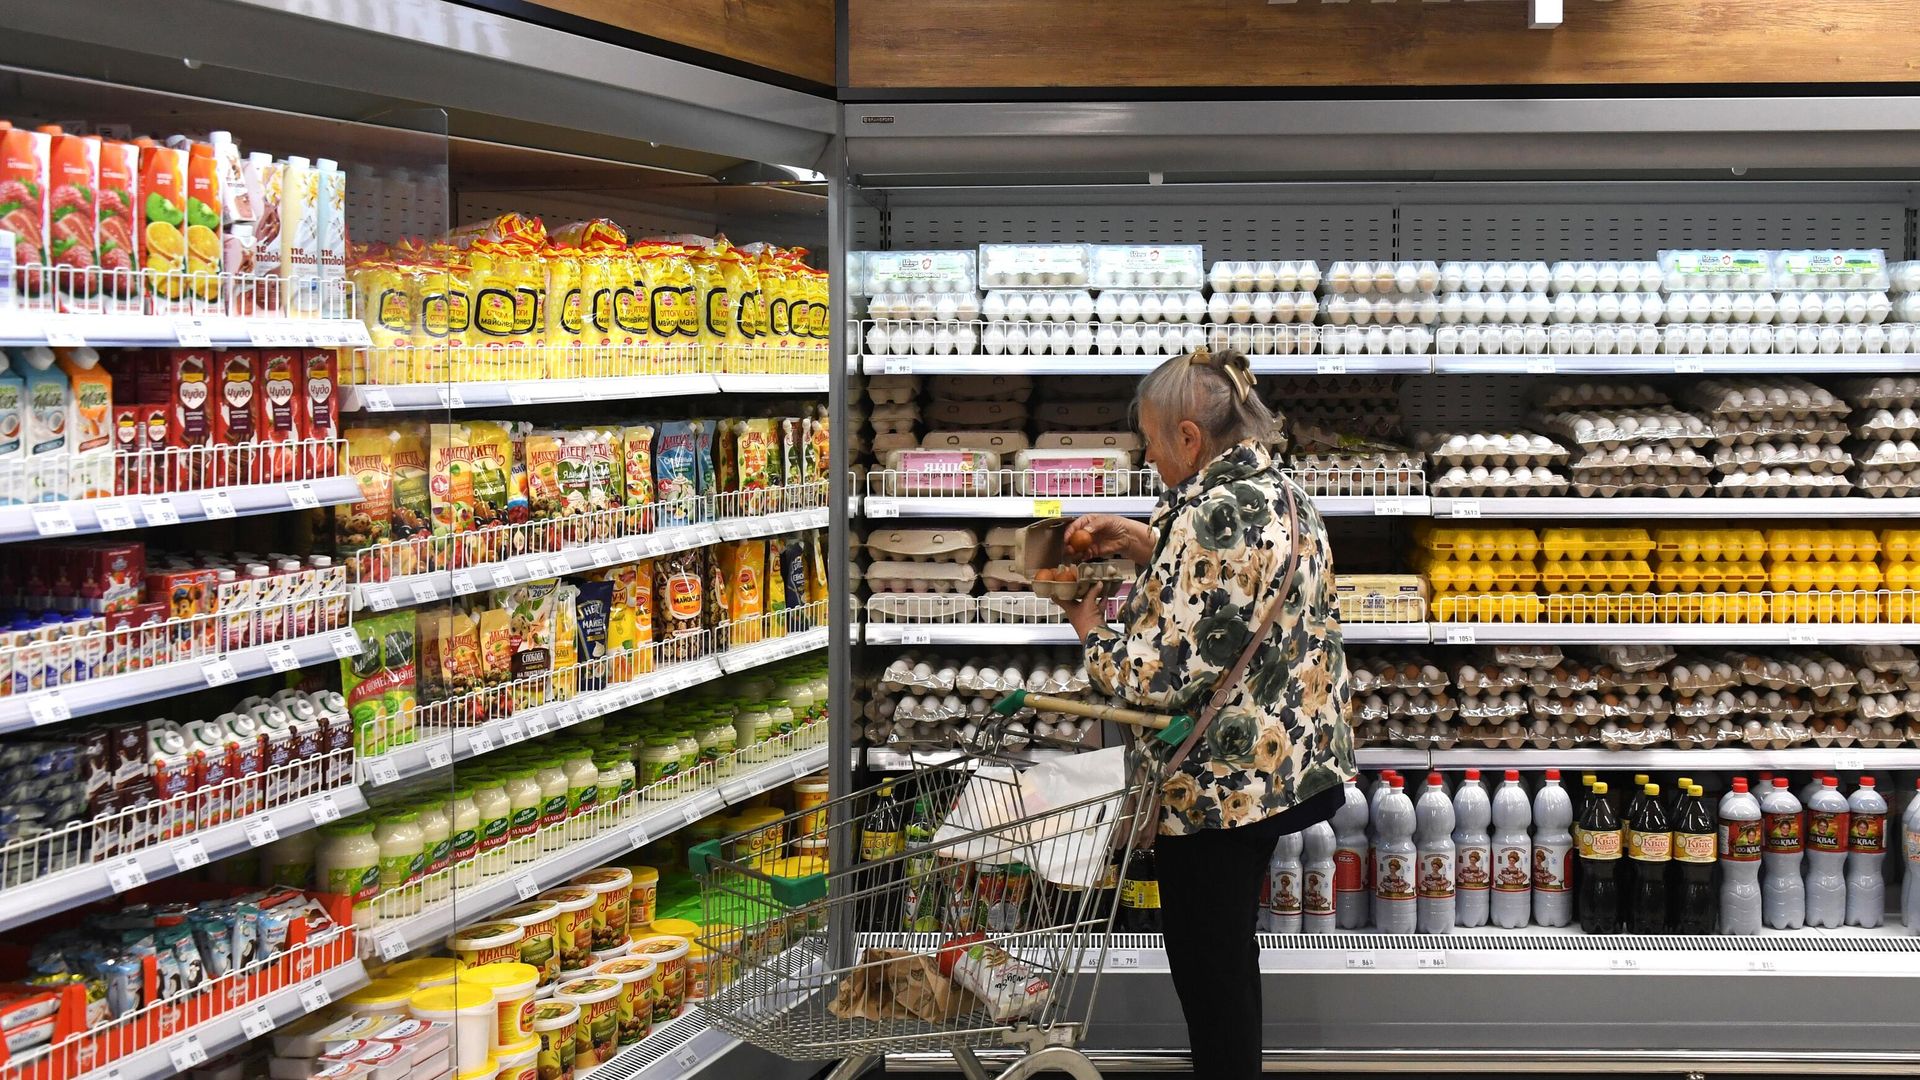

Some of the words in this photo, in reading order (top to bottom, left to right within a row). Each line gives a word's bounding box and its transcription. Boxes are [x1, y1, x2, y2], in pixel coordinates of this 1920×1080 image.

[291, 247, 304, 255] ne
[321, 249, 333, 257] ne
[182, 388, 205, 399] Чудо
[227, 387, 251, 400] Чудо
[269, 386, 291, 398] Чудо
[311, 383, 329, 396] Чудо
[1594, 837, 1619, 846] Квас
[1643, 839, 1668, 848] Квас
[1687, 840, 1712, 849] Квас
[1780, 838, 1799, 847] КВАС
[1816, 836, 1837, 845] КВАС
[1856, 838, 1877, 847] КВАС
[1088, 958, 1096, 966] 65
